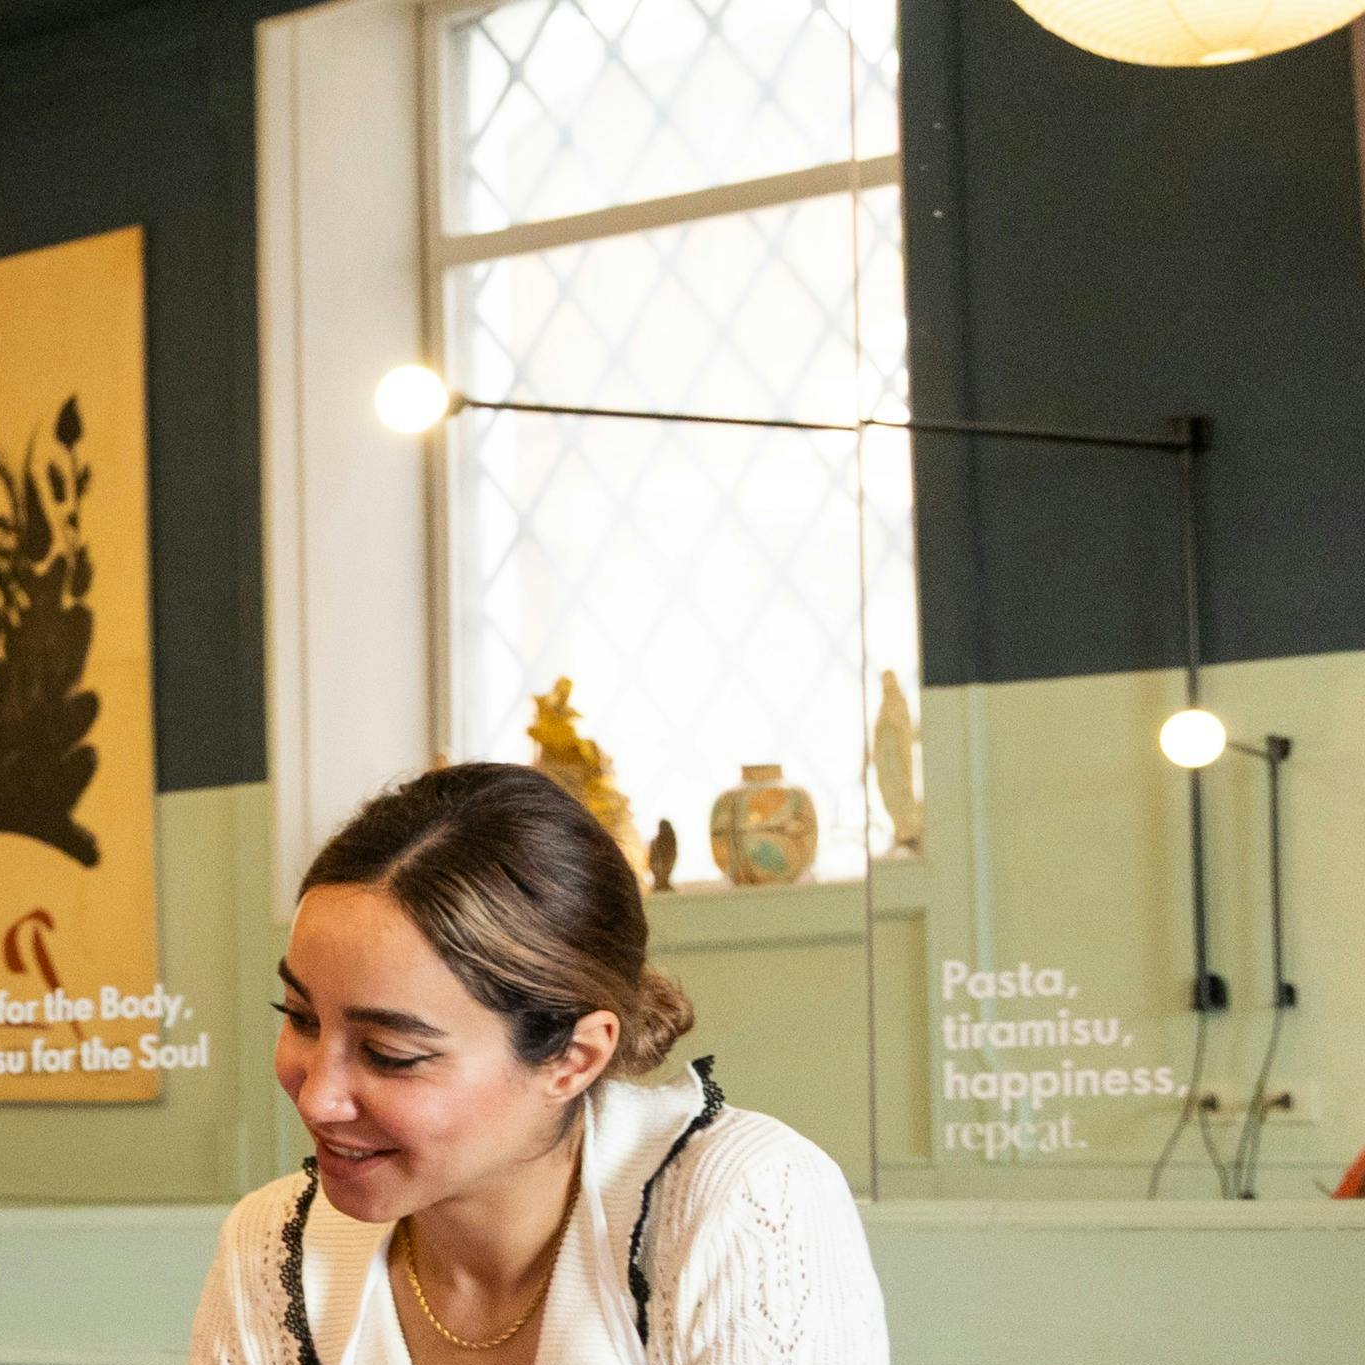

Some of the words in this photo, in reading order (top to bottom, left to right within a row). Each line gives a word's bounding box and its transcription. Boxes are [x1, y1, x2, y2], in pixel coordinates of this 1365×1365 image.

[941, 960, 1080, 1001] Pasta,
[43, 988, 94, 1024] the
[99, 983, 194, 1031] Body.
[942, 1009, 1136, 1050] tiramisu,
[31, 1037, 76, 1074] for
[80, 1036, 134, 1072] the
[138, 1033, 210, 1071] Soul
[943, 1059, 1192, 1111] happiness,
[944, 1116, 1089, 1159] repeat.
